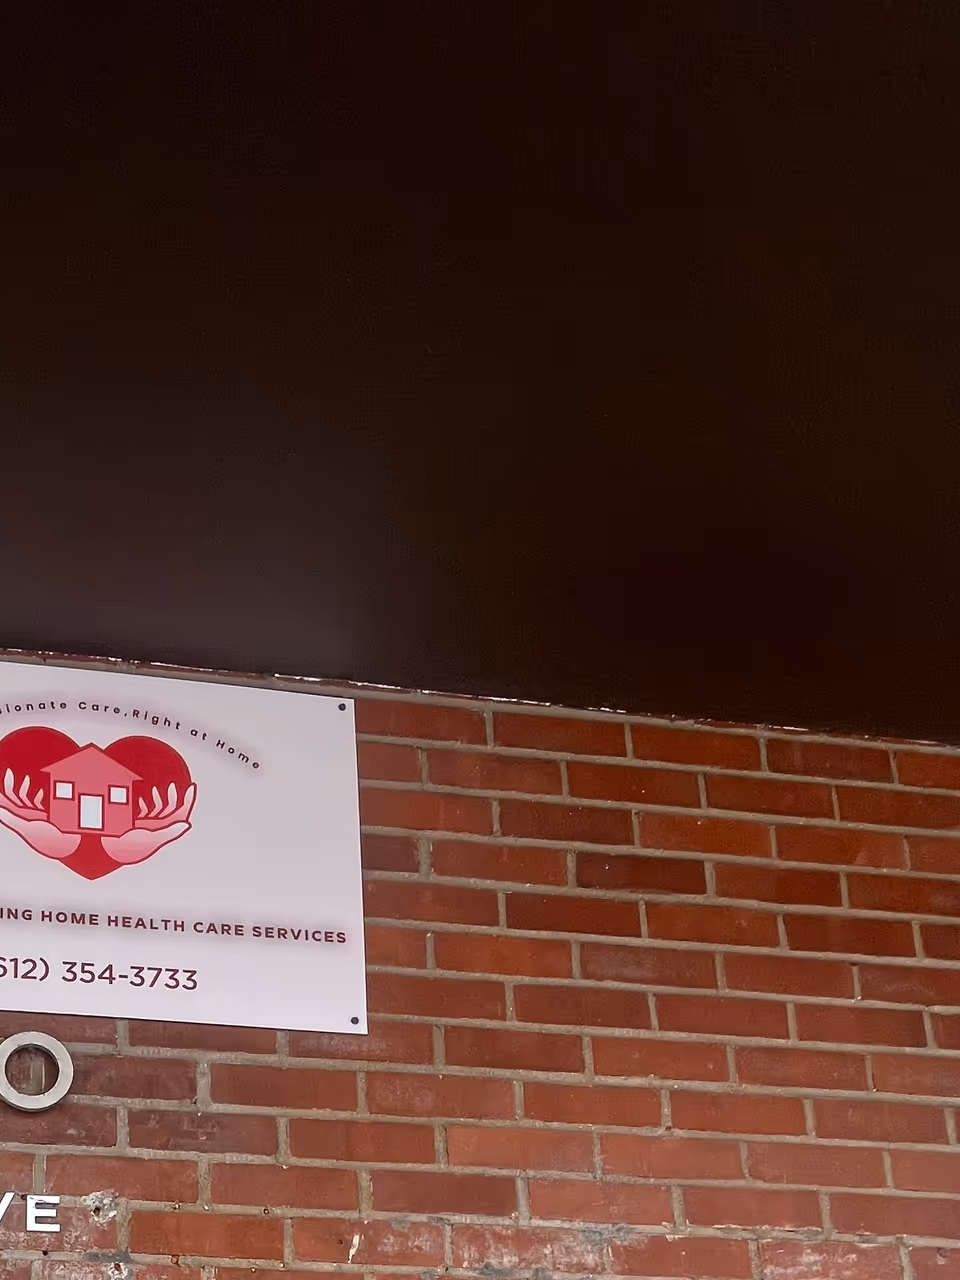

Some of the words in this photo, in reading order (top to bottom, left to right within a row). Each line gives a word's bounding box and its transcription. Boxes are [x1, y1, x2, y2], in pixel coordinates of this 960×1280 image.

[189, 727, 207, 742] at
[215, 738, 260, 770] Home
[40, 909, 100, 926] HOME
[106, 914, 186, 933] HEALTH
[192, 921, 245, 937] CARE
[251, 925, 348, 945] SERVICES
[61, 959, 198, 992] 354-3733
